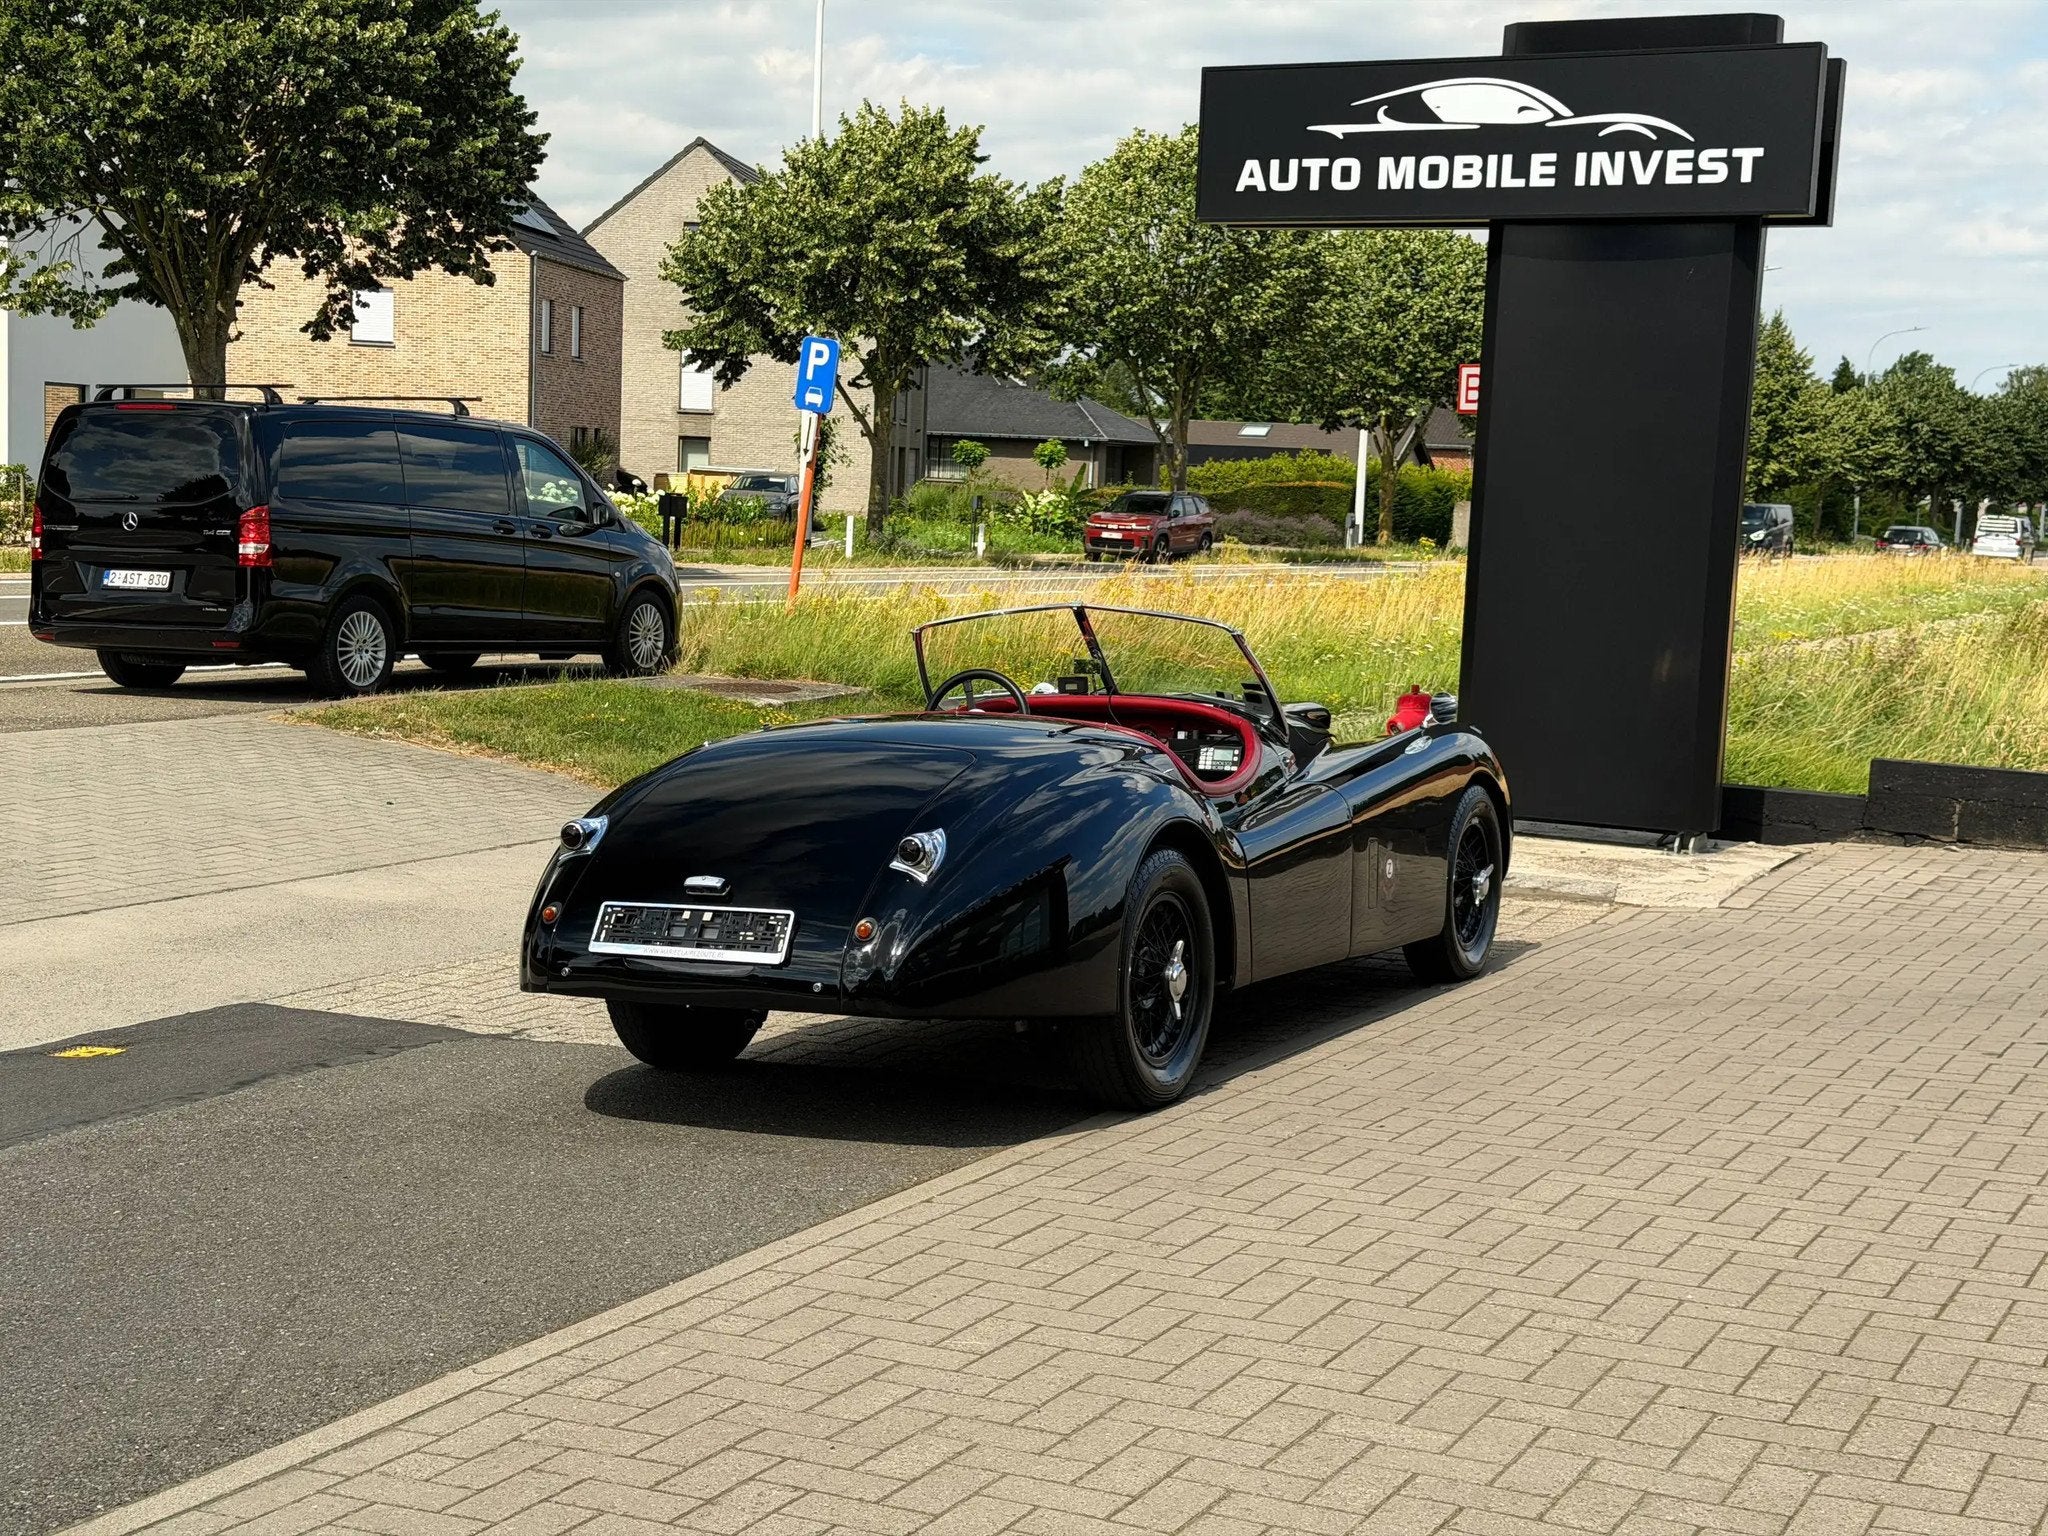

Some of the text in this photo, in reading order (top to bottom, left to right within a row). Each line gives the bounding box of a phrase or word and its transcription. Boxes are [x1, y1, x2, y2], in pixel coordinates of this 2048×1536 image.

[1236, 148, 1764, 191] AUTO MOBILE INVEST
[806, 342, 830, 380] P
